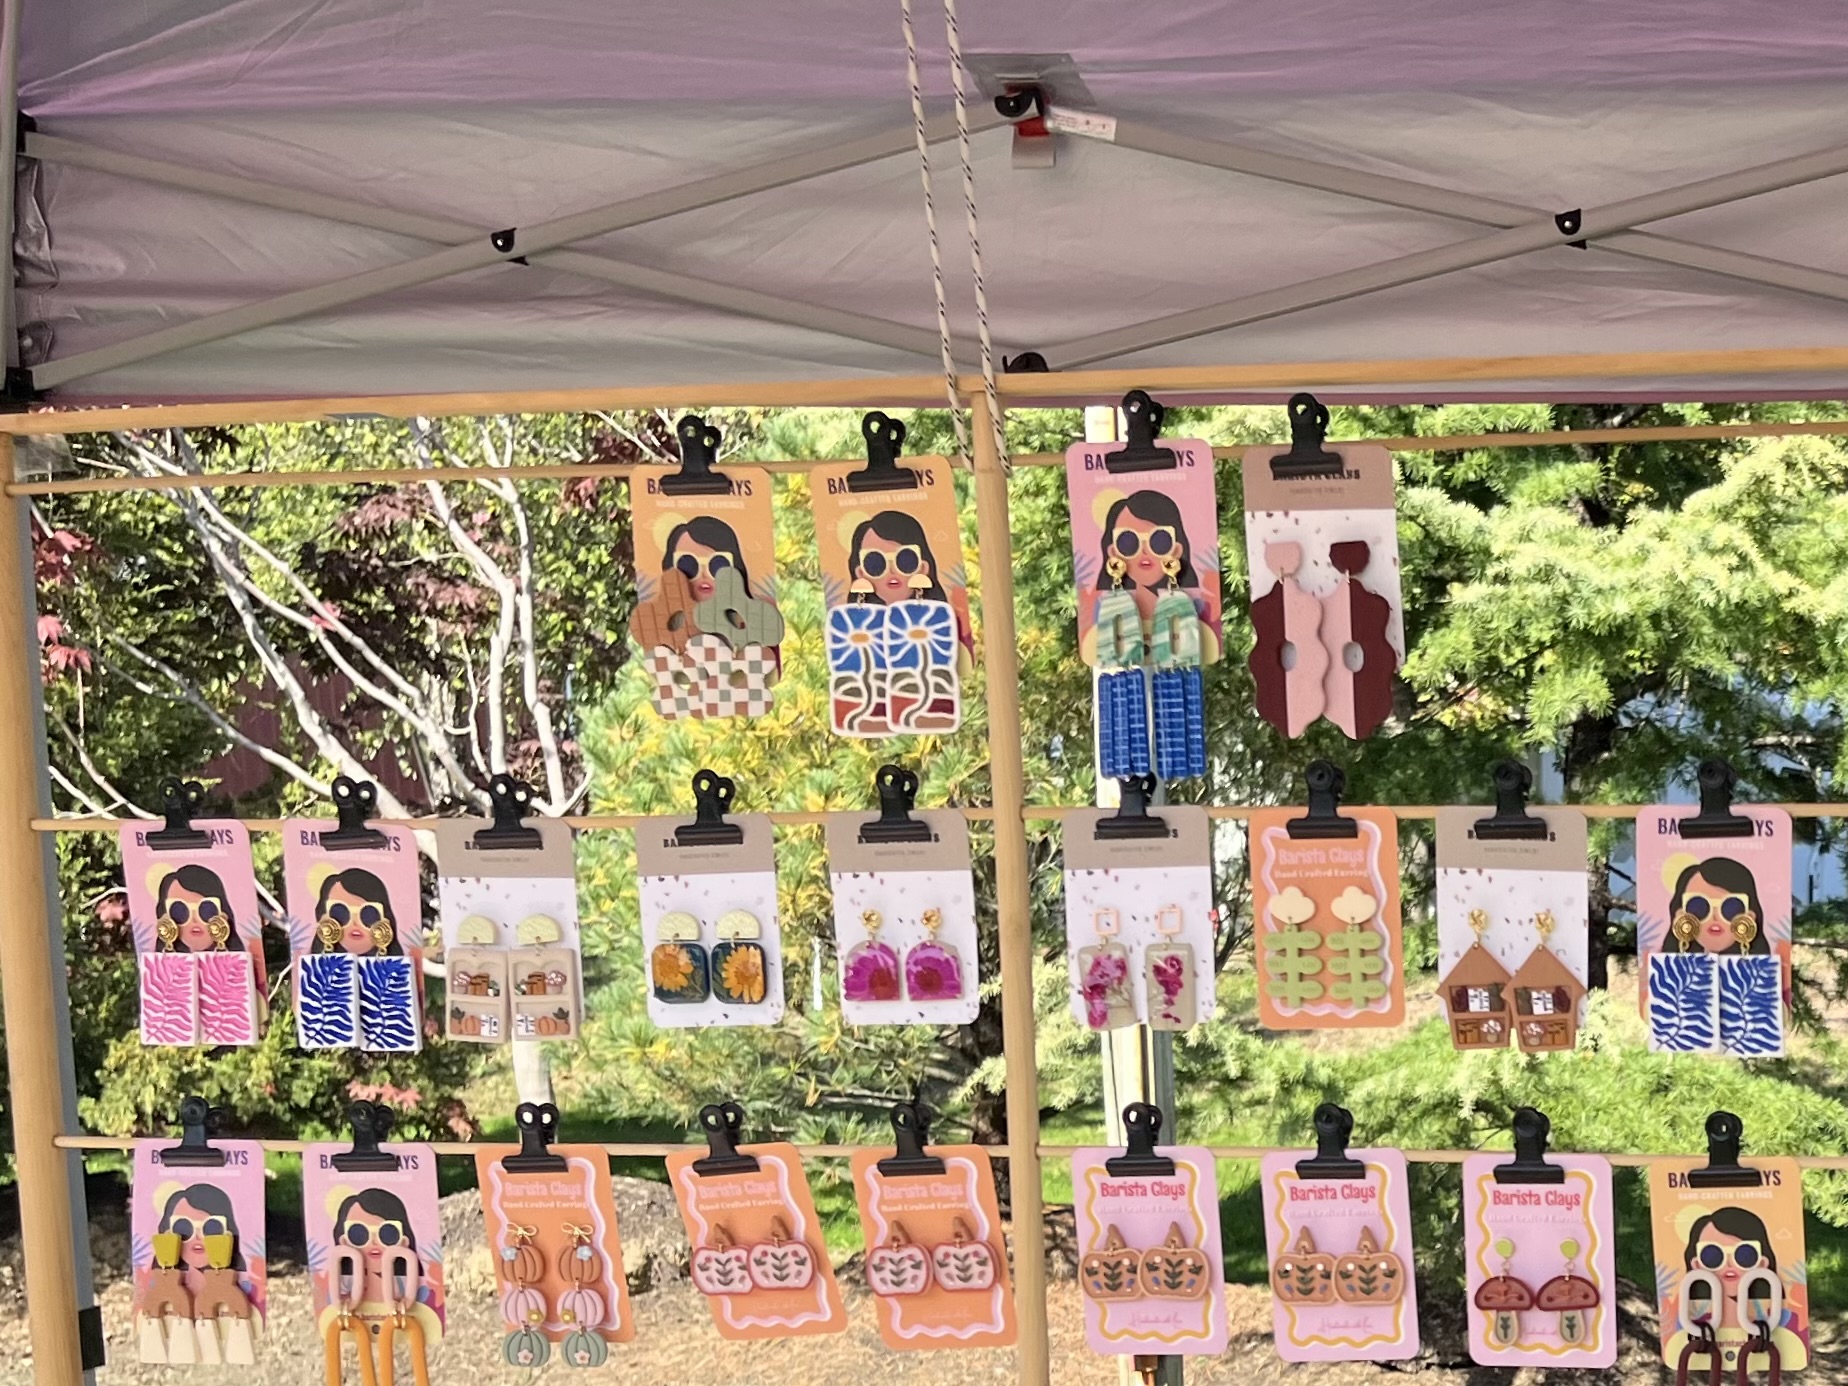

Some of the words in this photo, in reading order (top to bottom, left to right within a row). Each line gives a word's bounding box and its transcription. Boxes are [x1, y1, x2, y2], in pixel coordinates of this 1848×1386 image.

[1101, 1182, 1147, 1197] Barista
[1151, 1181, 1185, 1200] Clays
[1290, 1185, 1336, 1201] Barista
[1341, 1184, 1376, 1203] Clays
[1494, 1190, 1540, 1206] Barista
[1545, 1191, 1580, 1210] Clays
